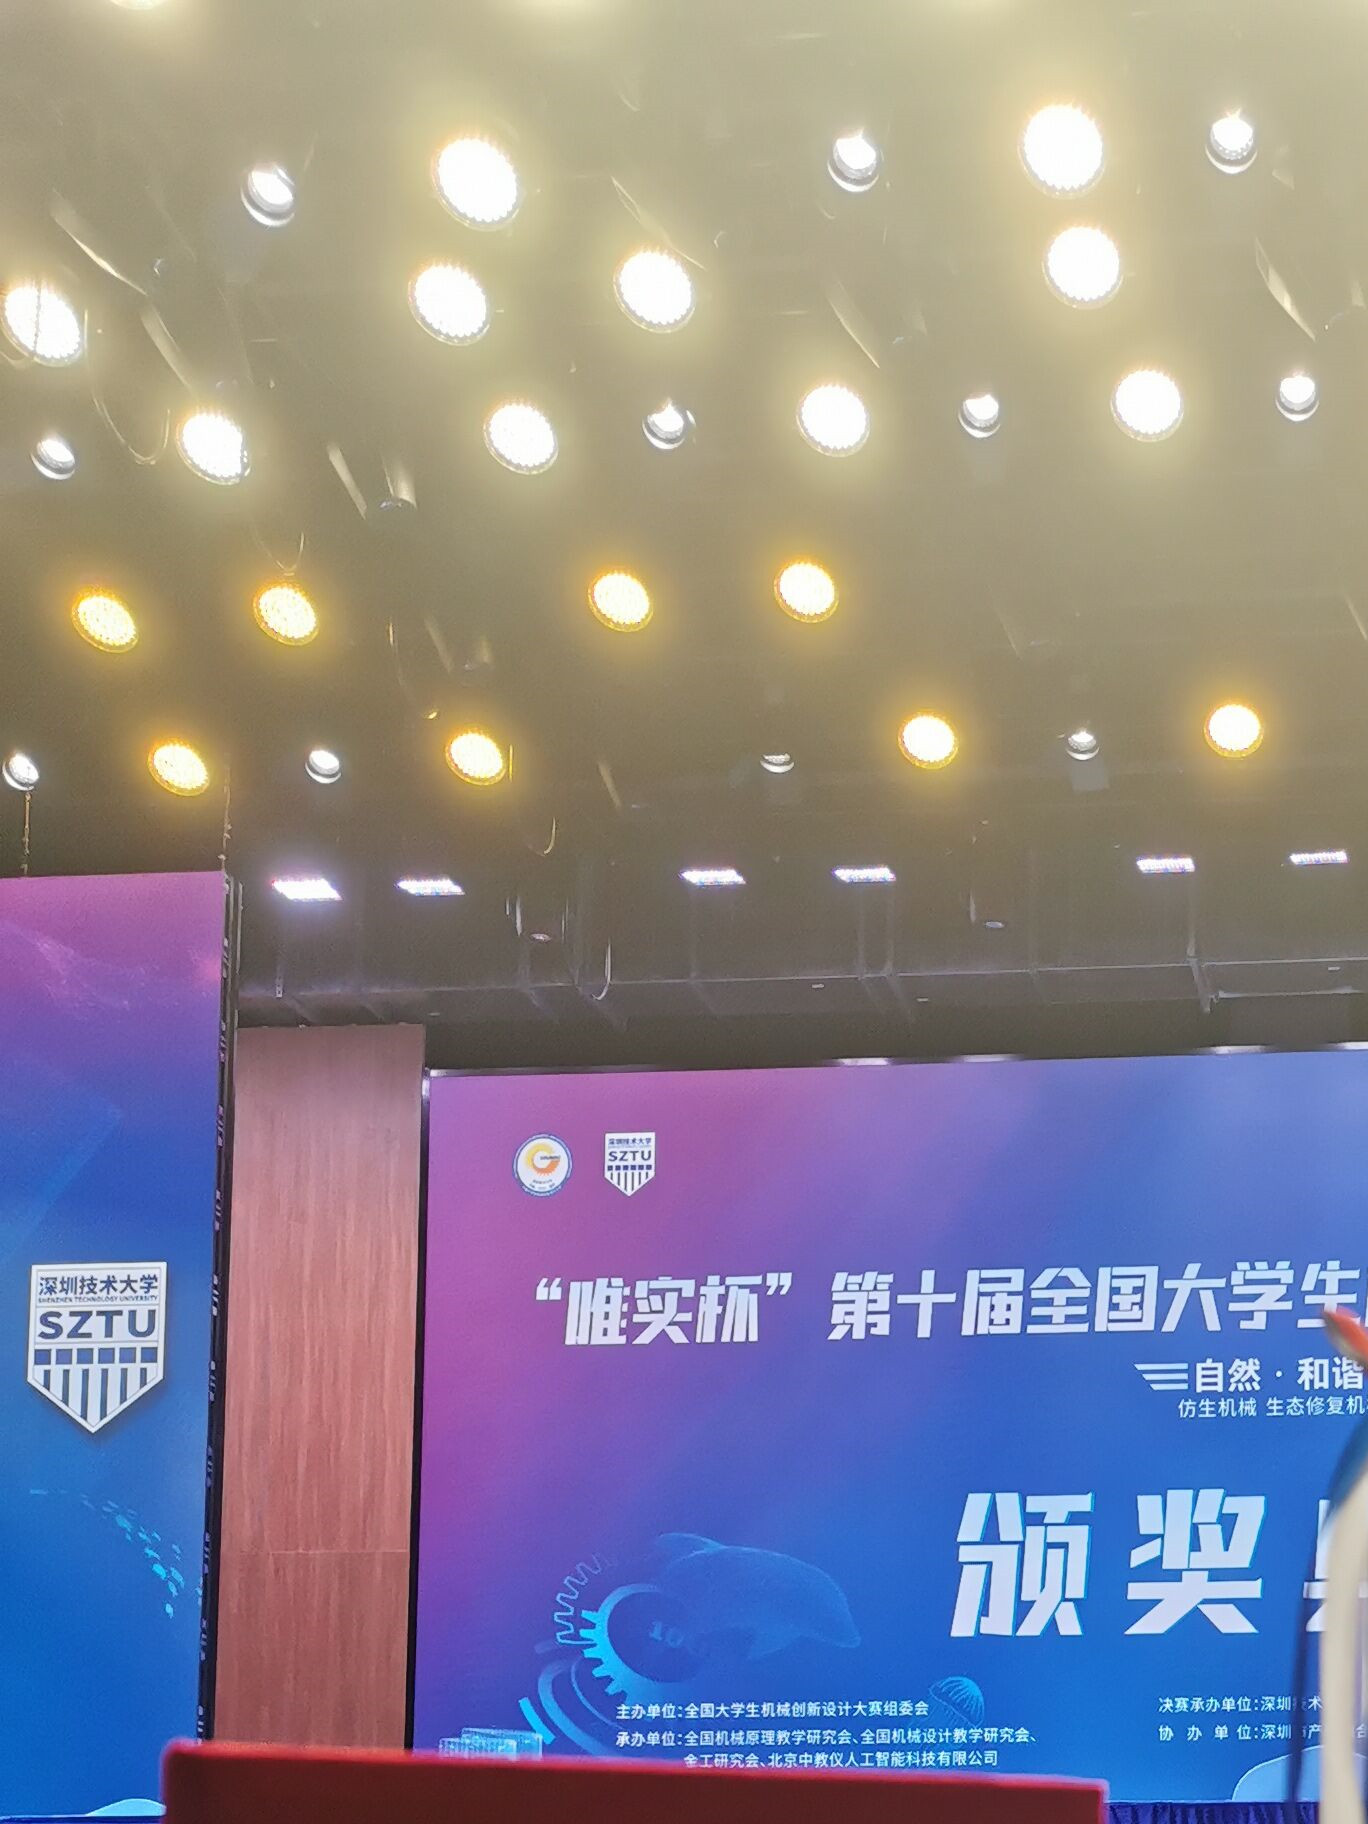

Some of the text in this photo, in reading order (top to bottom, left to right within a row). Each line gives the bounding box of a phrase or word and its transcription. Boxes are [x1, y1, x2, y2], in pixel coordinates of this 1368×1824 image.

[608, 1150, 652, 1162] SZTU
[38, 1274, 158, 1295] 深圳技术大学
[534, 1271, 793, 1346] “唯实杯”
[38, 1309, 157, 1340] SZTU
[1177, 1397, 1258, 1419] 仿生机械
